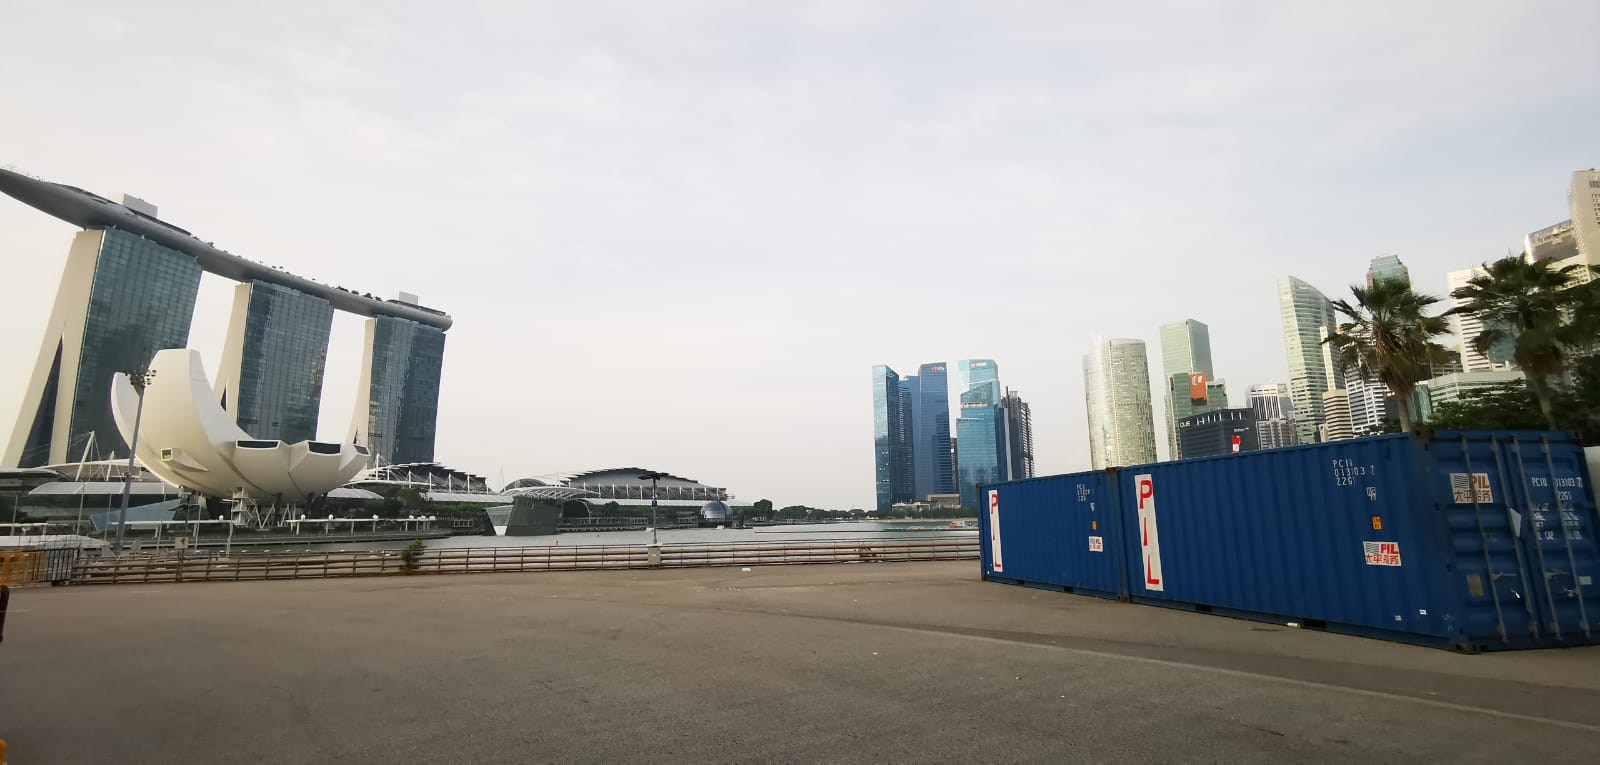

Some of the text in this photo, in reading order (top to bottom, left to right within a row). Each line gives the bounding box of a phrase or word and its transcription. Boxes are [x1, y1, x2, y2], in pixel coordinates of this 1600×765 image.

[1471, 475, 1489, 489] PIL
[991, 494, 1001, 568] PIL
[1139, 479, 1159, 585] PIL
[1380, 543, 1398, 554] PIL
